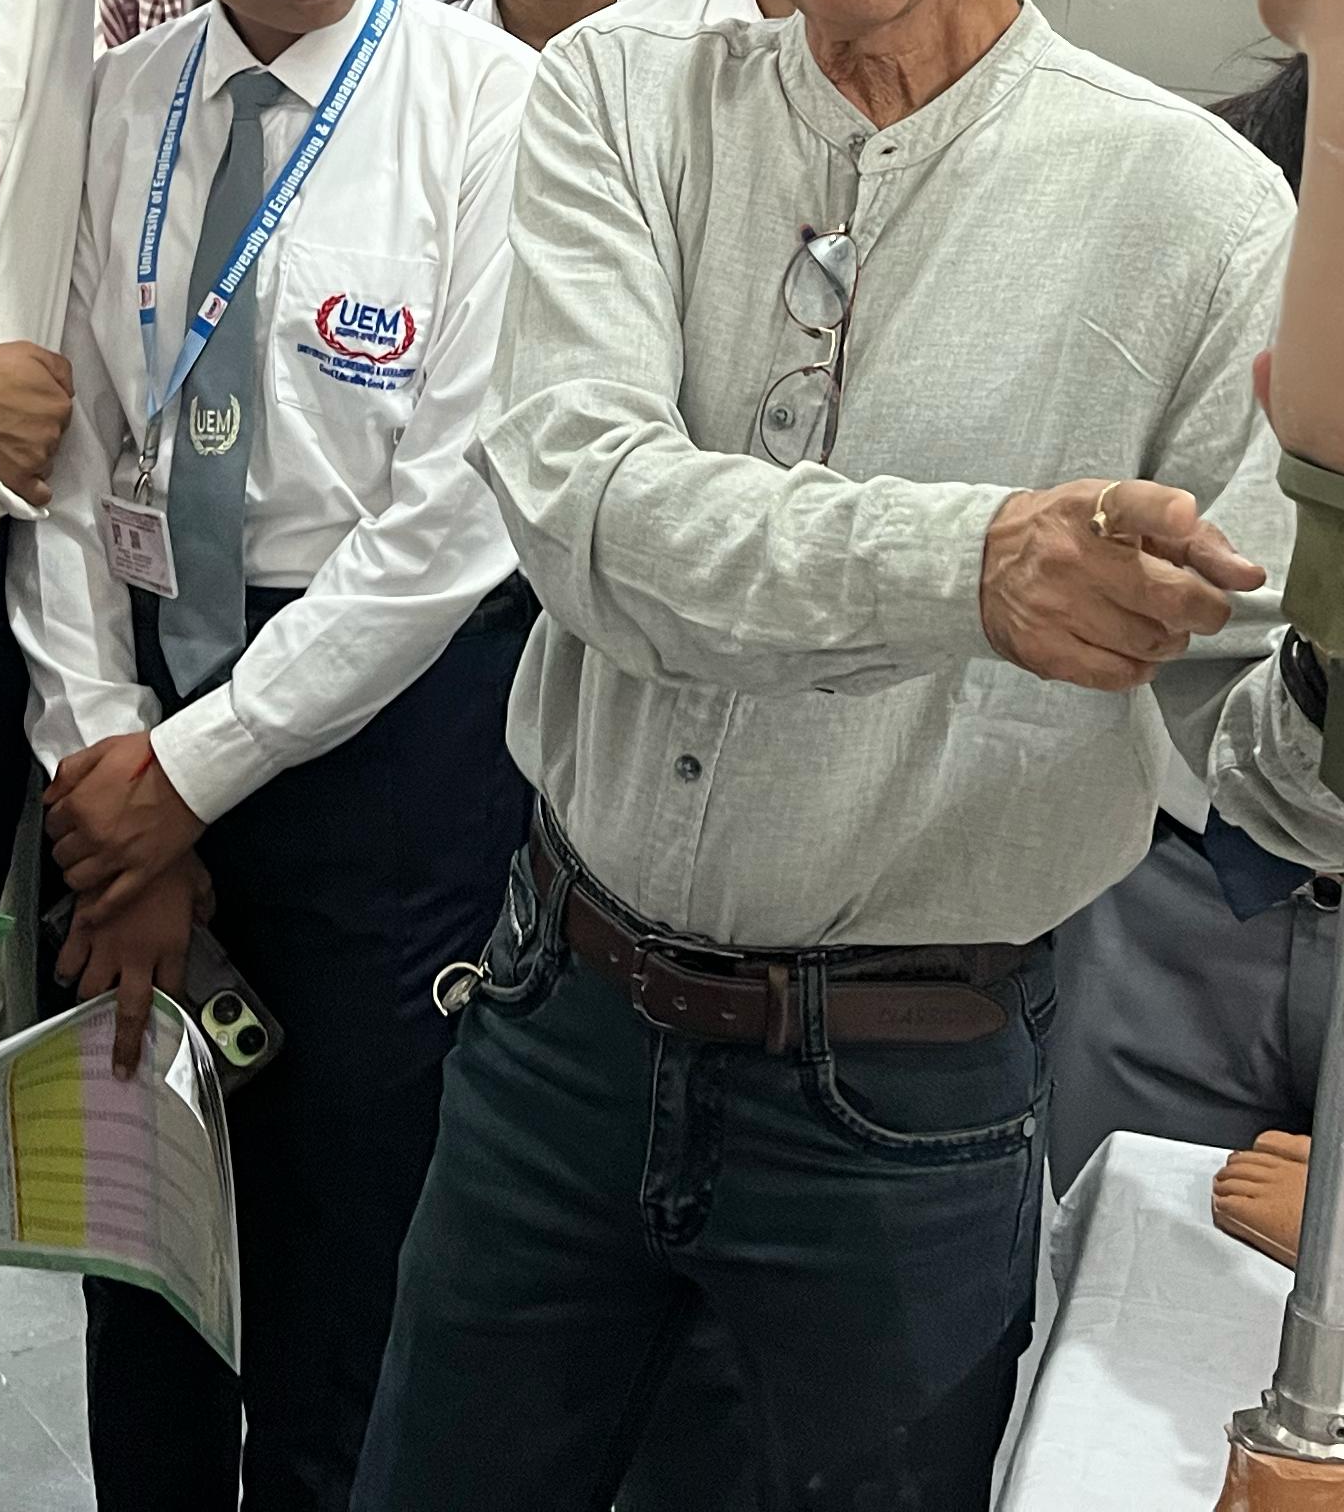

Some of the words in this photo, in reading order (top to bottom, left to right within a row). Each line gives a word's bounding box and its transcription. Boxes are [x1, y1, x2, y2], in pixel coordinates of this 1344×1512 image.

[315, 123, 331, 136] &
[268, 136, 325, 212] Engineering
[139, 207, 161, 275] University
[153, 110, 183, 187] Engineering
[262, 211, 277, 228] of
[219, 226, 269, 294] University
[338, 299, 401, 335] UEM
[197, 408, 231, 433] UEM
